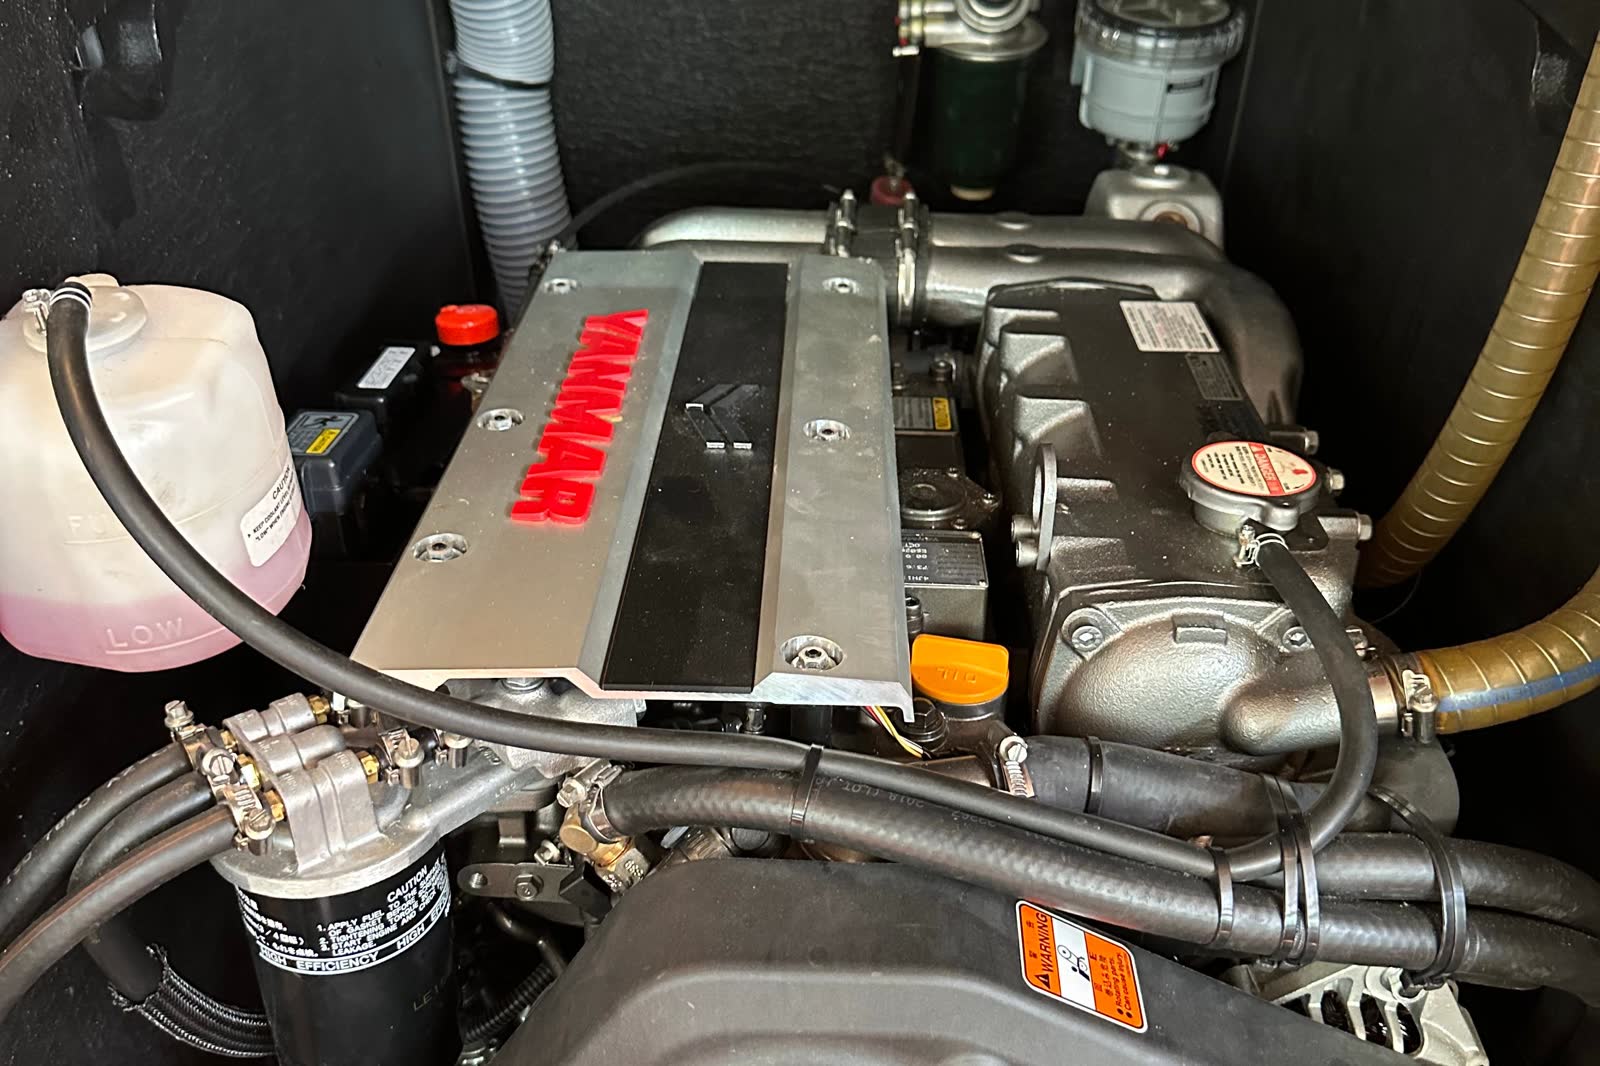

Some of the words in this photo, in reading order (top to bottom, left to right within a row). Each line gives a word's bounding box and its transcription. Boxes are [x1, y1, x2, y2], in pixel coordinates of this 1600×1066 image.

[511, 309, 649, 526] YANMAR
[272, 464, 290, 500] CAUTION
[106, 617, 183, 647] LOW
[936, 667, 976, 684] OIL
[387, 864, 427, 903] CAUTION
[327, 918, 358, 931] APPLY
[361, 909, 385, 922] FUEL
[388, 900, 400, 911] TO
[403, 887, 418, 901] THE
[328, 929, 342, 937] OF
[346, 917, 382, 934] GASKET
[386, 896, 416, 920] BEFORE
[330, 923, 385, 943] TIGHTENING
[388, 900, 419, 925] TORQUE
[260, 946, 287, 966] HIGH
[296, 951, 379, 972] EFFICIENCY
[396, 923, 425, 949] HIGH
[331, 939, 362, 950] START
[366, 923, 398, 941] ENGINE
[400, 911, 417, 926] AND
[332, 940, 377, 956] LEAKAGE.
[1036, 912, 1054, 973] WARNING
